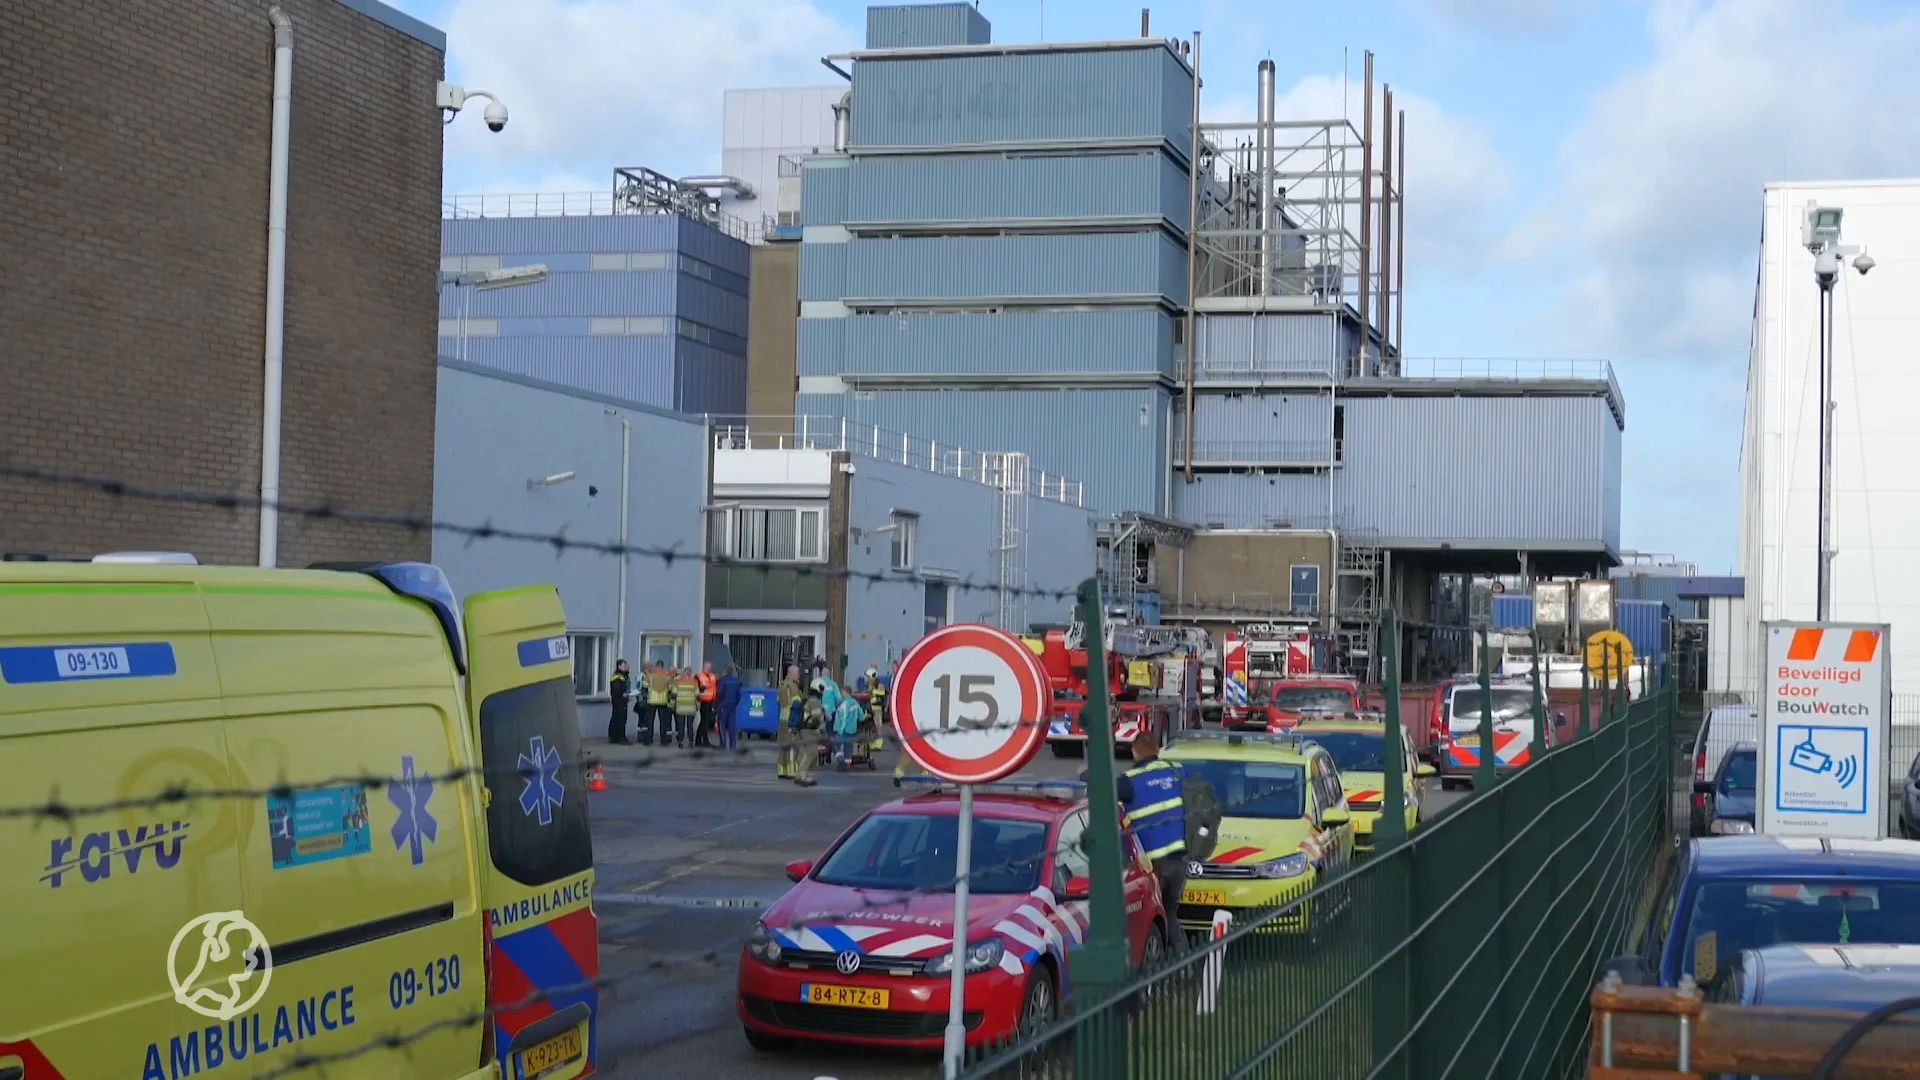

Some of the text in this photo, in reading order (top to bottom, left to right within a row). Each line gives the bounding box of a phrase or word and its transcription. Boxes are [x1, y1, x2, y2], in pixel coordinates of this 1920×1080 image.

[67, 651, 118, 672] 09-130
[1778, 666, 1861, 684] Beveiligd
[933, 673, 999, 729] 15
[1777, 700, 1869, 716] BouWatch
[1778, 684, 1819, 697] door
[48, 820, 184, 888] ravu
[491, 878, 589, 927] AMBULANCE
[389, 953, 460, 1009] 09-130
[813, 986, 881, 1006] 84-RTZ-8
[142, 985, 355, 1080] AMBULANCE
[526, 1032, 577, 1072] K-923-TK
